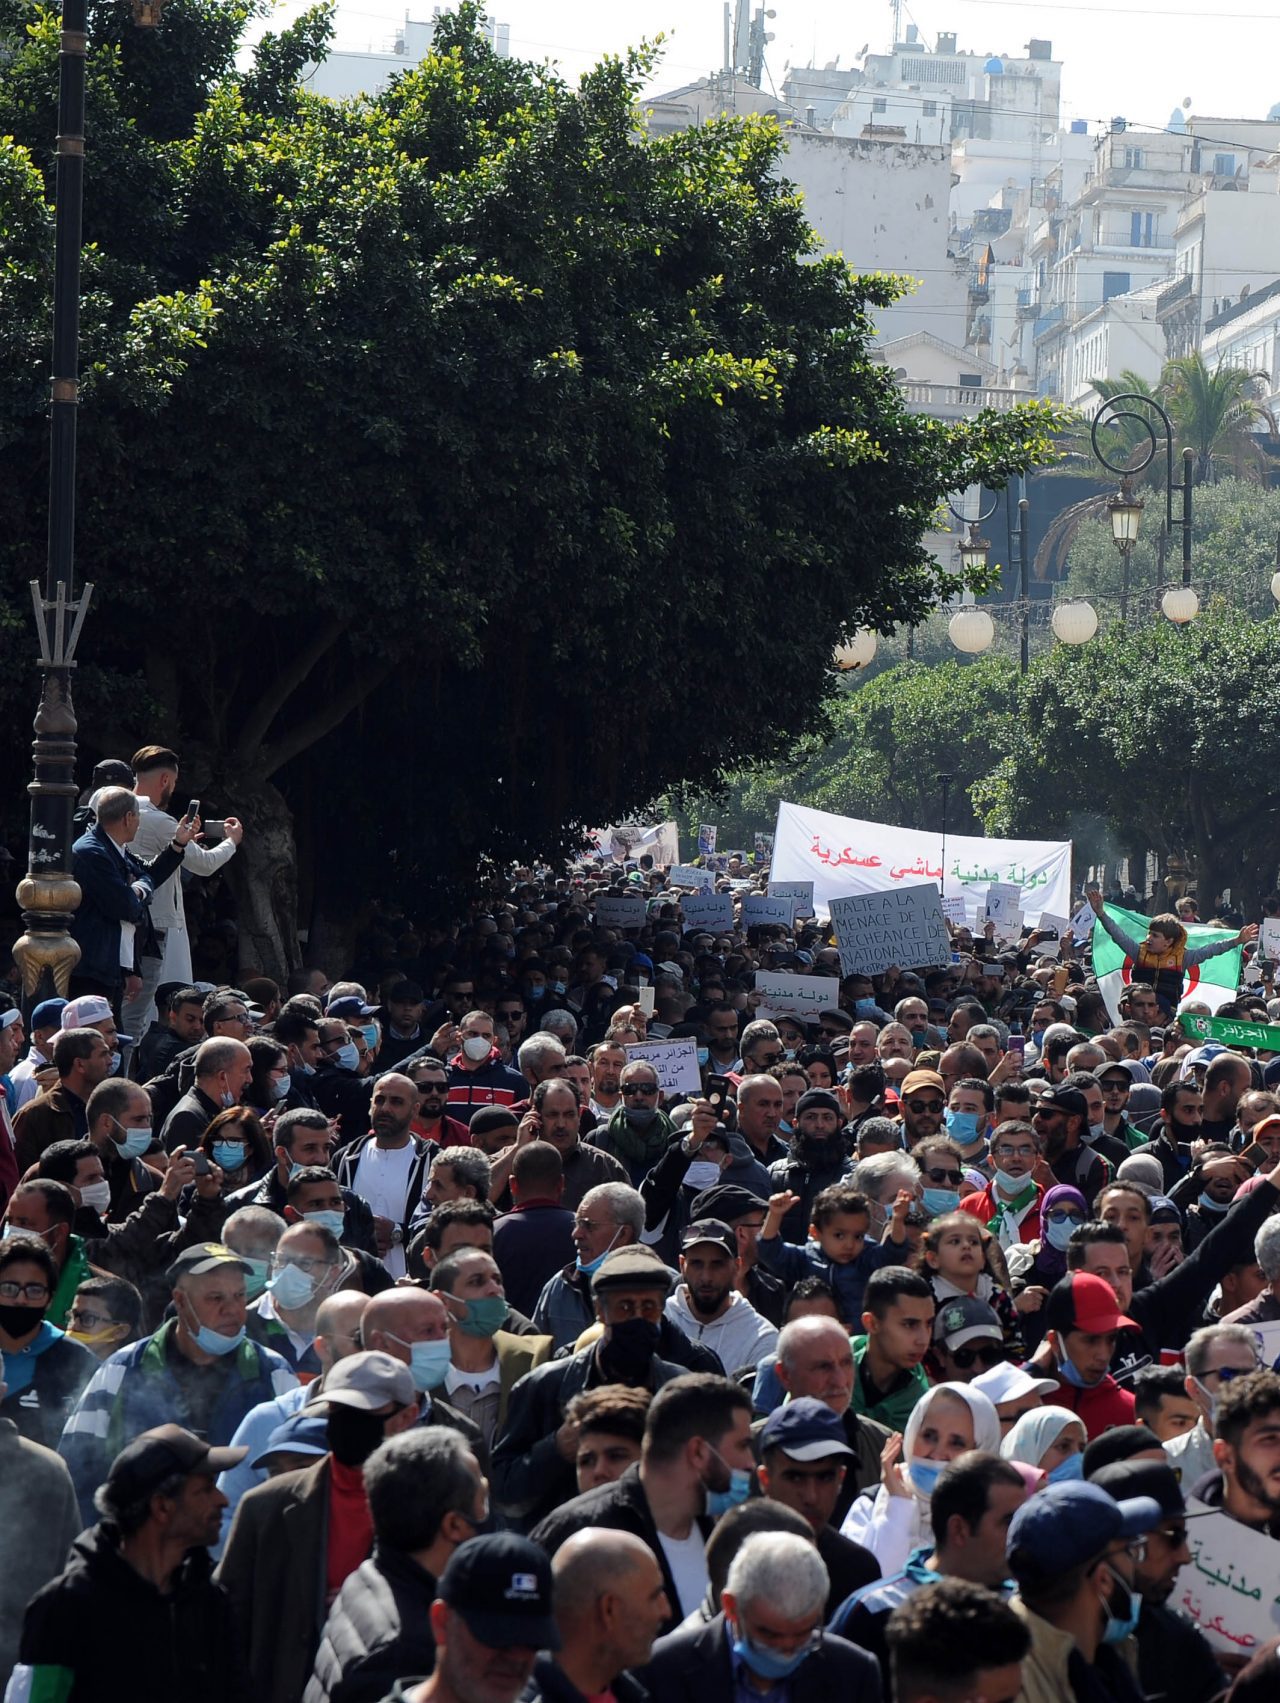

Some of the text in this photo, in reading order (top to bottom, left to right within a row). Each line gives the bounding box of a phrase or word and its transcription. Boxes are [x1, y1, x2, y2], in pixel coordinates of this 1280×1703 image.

[810, 836, 1047, 889] دولة مدنية ماشي عسكرية
[833, 893, 914, 915] HALTE A LA
[835, 913, 892, 932] MENACE
[900, 911, 916, 923] DE
[923, 906, 941, 920] LA
[927, 924, 945, 938] DE
[761, 984, 829, 1003] دولة مدنية
[1220, 1023, 1268, 1041] الجزائر
[629, 1045, 695, 1061] الجزائر مريضة
[671, 1064, 684, 1074] من
[1190, 1540, 1261, 1600] مدنية
